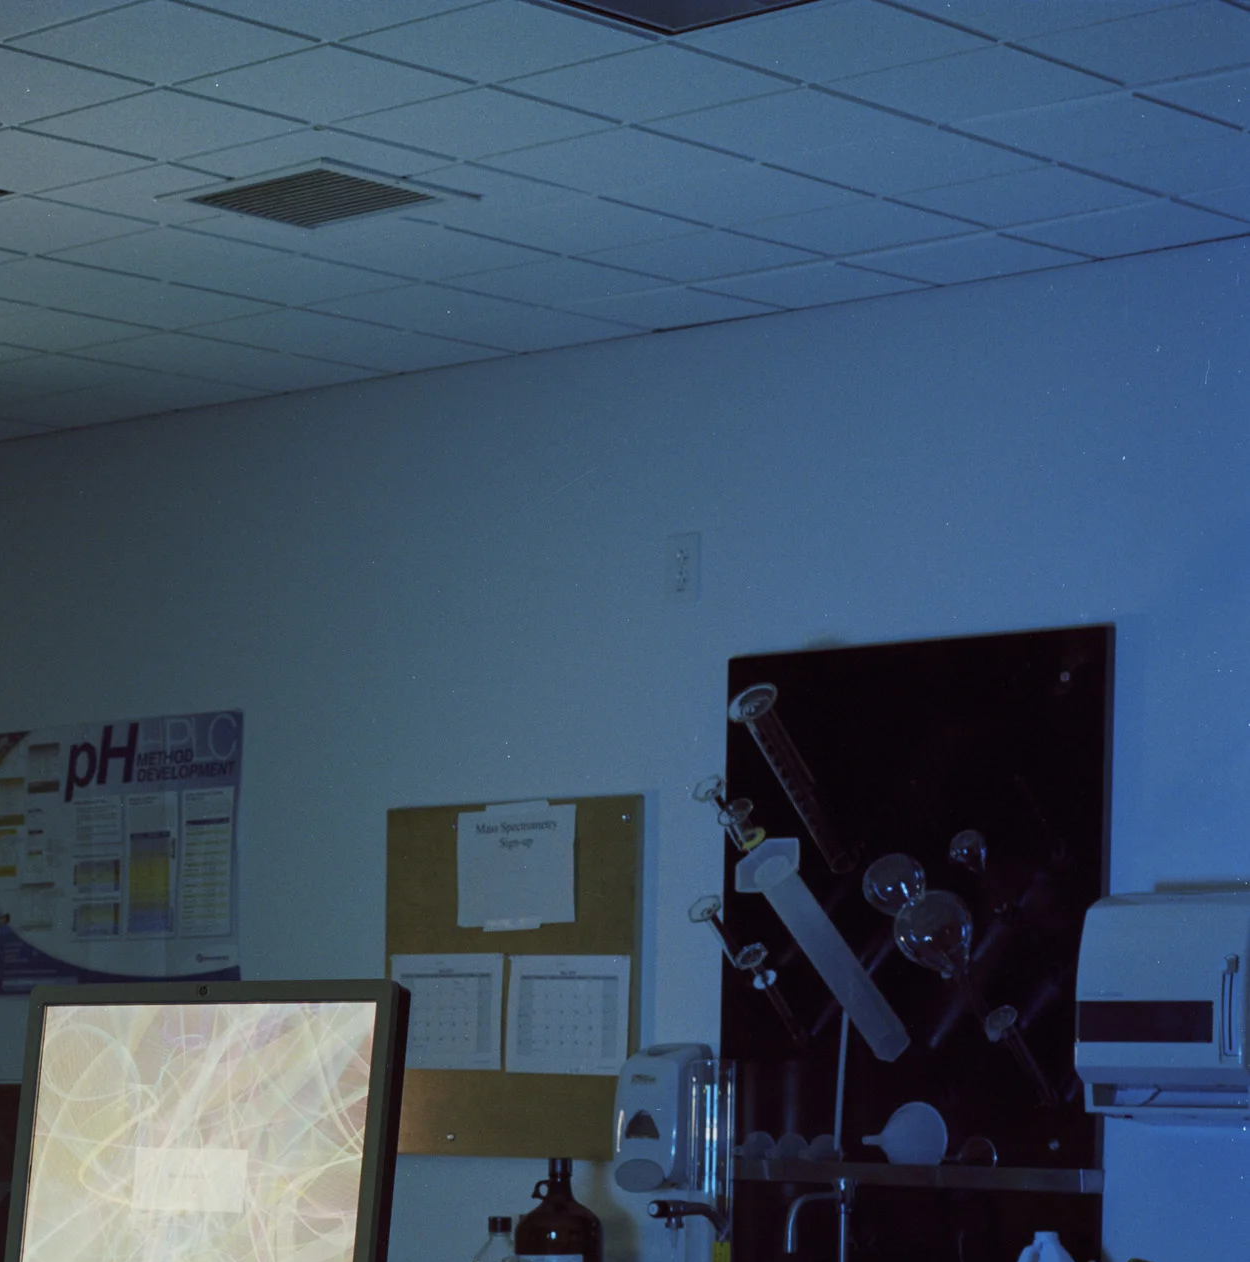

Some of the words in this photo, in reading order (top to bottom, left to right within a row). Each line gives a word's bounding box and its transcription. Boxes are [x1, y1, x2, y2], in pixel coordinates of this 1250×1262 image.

[63, 721, 140, 804] pH
[136, 747, 195, 768] METHOD
[136, 760, 237, 783] DEVELOPMENT
[475, 821, 499, 835] Mass
[499, 819, 559, 836] Spectrometry
